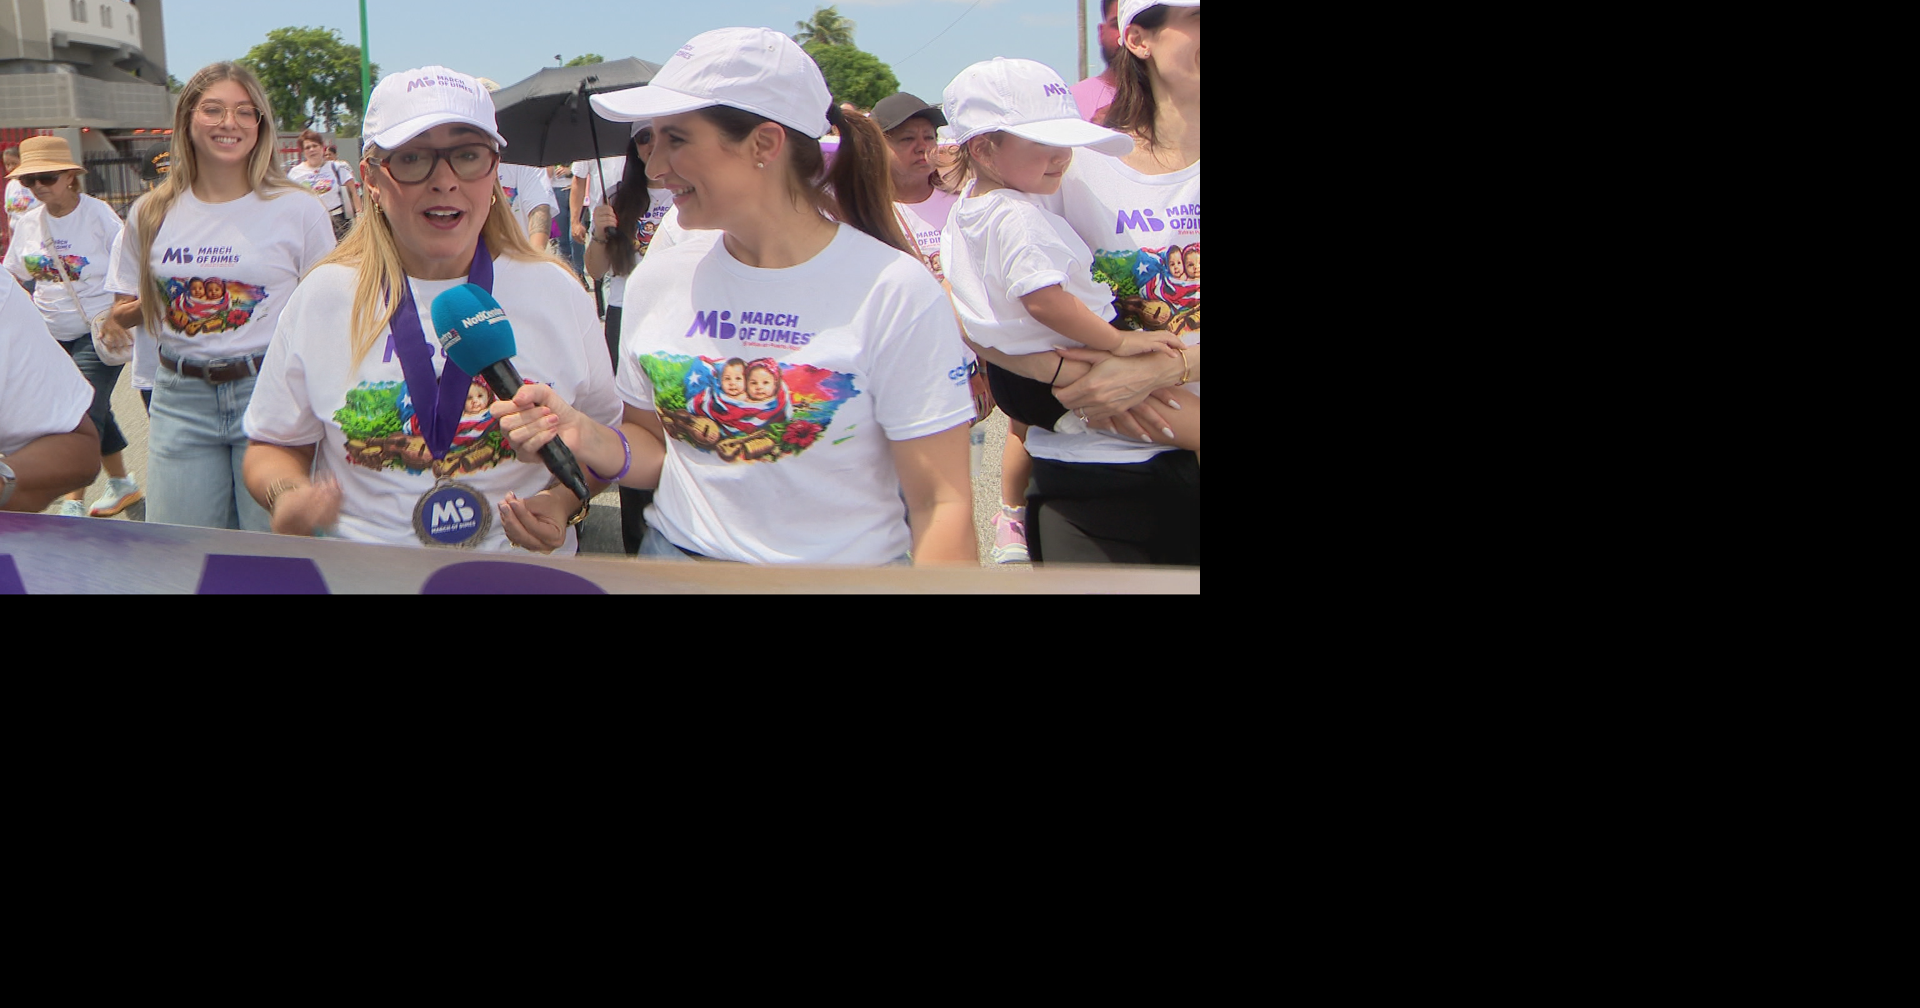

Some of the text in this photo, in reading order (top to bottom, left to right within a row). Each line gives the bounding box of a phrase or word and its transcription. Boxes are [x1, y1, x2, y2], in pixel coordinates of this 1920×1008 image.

[198, 246, 232, 255] MARCH
[210, 255, 240, 263] DIMES
[740, 311, 799, 328] MARCH
[739, 327, 757, 340] OF
[758, 328, 812, 346] DIMES
